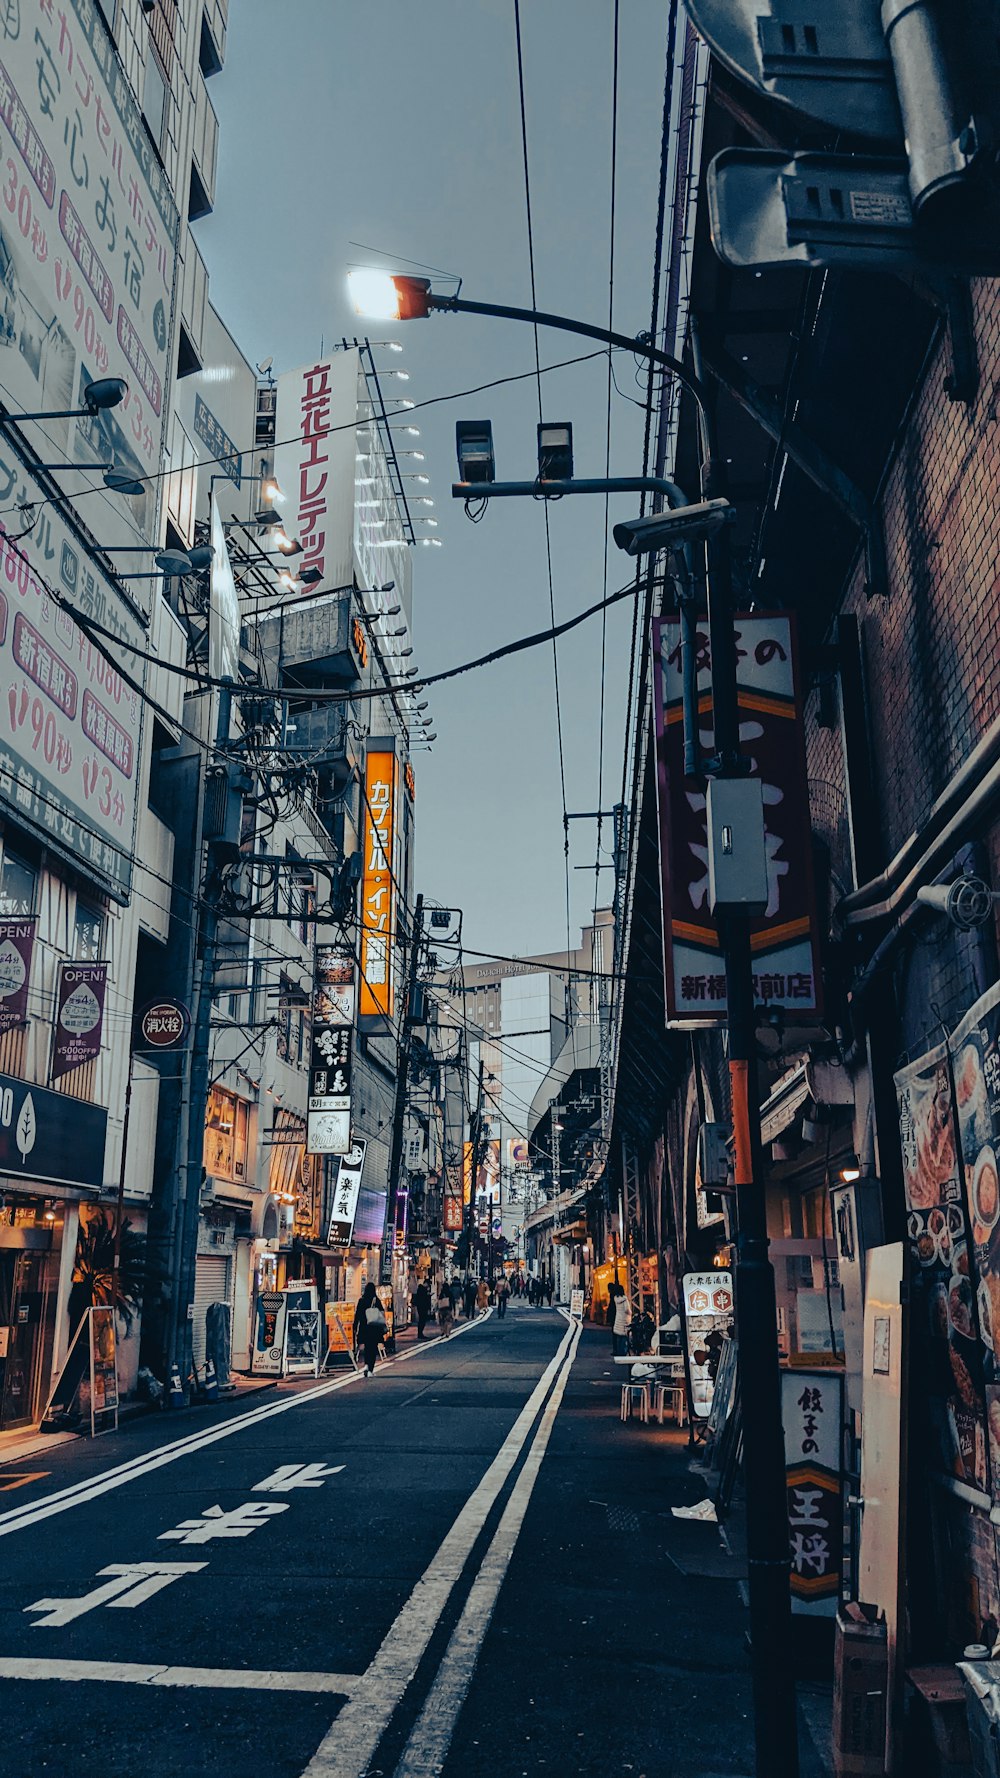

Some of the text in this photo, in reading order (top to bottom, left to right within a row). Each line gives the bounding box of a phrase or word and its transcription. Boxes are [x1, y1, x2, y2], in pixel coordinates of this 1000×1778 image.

[34, 27, 144, 309] 安心お宿
[5, 157, 48, 263] 30秒
[74, 284, 109, 373] 90秒
[130, 394, 154, 458] 3分
[298, 364, 331, 595] 立花エレテック
[19, 626, 72, 708] 新宿駅より
[31, 697, 73, 774] 90秒
[86, 699, 129, 769] 秋葉原駅より
[98, 766, 126, 827] 3分
[64, 970, 104, 982] OPEN!
[681, 973, 811, 1000] 新橋前店
[147, 1017, 180, 1033] 消火栓
[716, 1292, 729, 1309] 串
[797, 1386, 824, 1455] 餃子の
[789, 1488, 830, 1575] 王将
